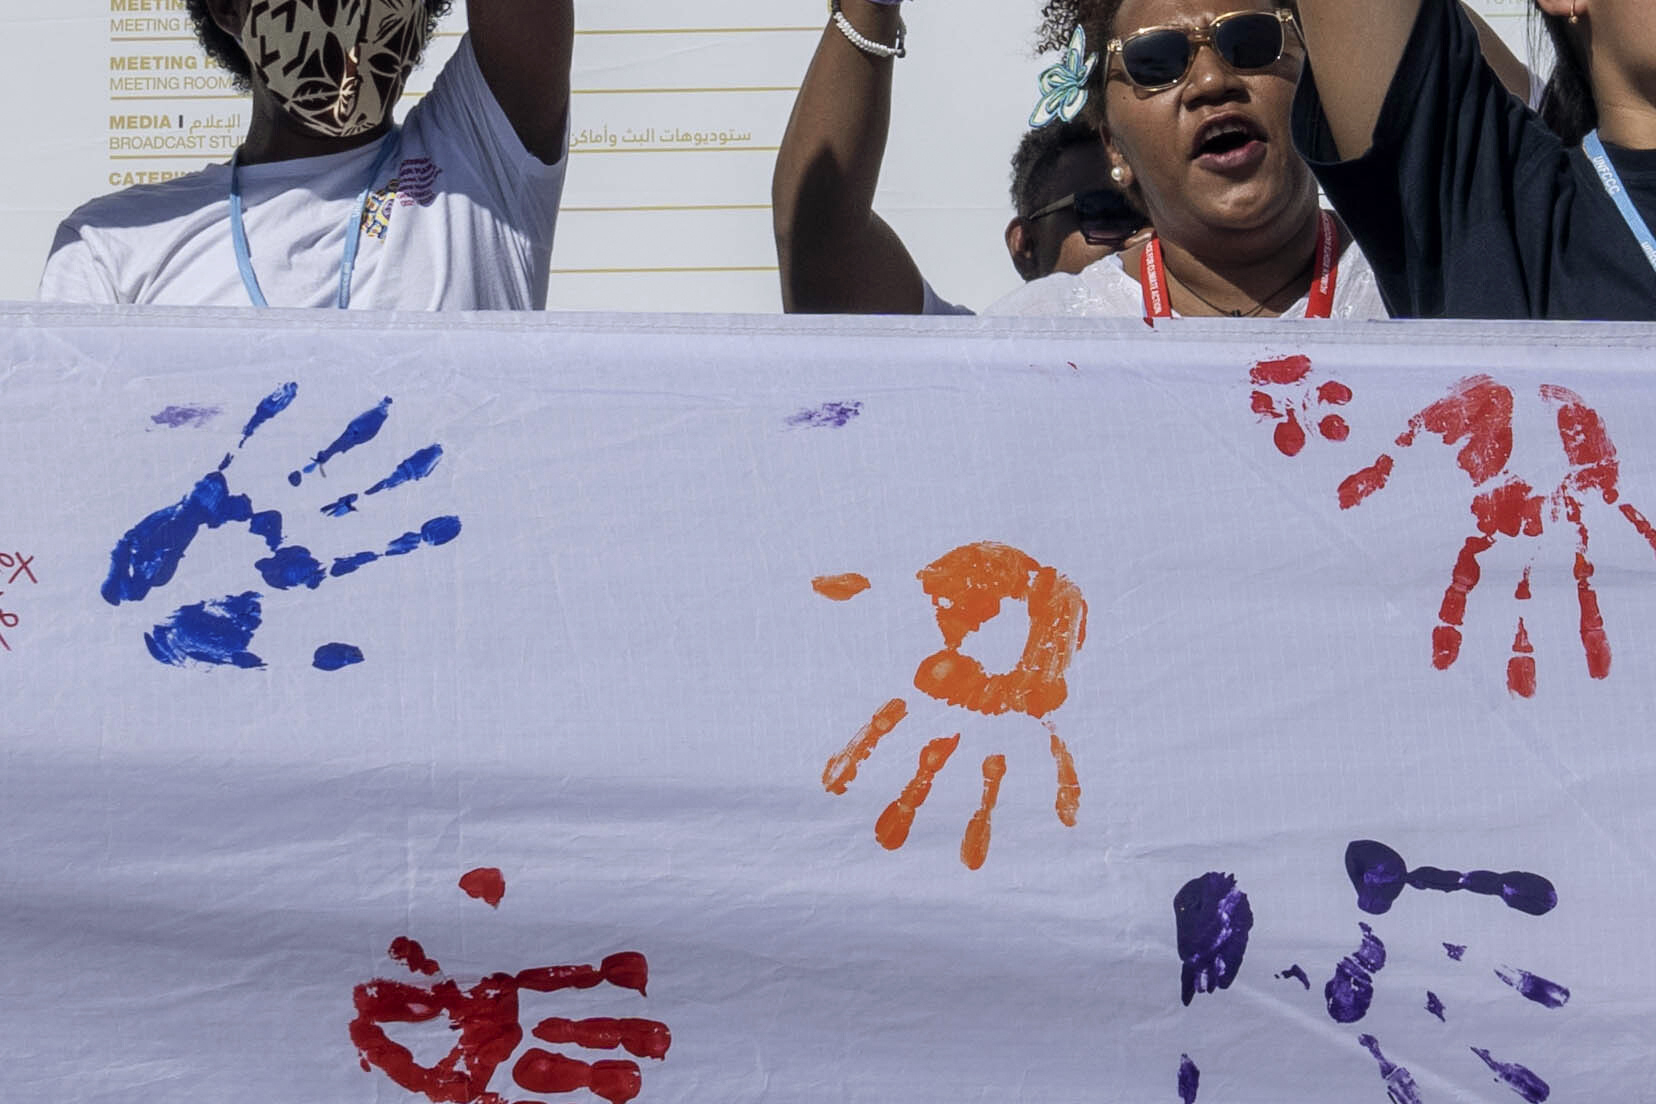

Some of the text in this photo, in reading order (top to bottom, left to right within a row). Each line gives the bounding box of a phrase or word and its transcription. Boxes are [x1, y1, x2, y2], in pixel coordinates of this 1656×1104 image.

[110, 18, 181, 33] MEETING
[109, 55, 198, 71] MEETING
[109, 76, 180, 91] MEETING
[108, 114, 172, 130] MEDIA
[108, 135, 207, 151] BROADCAST
